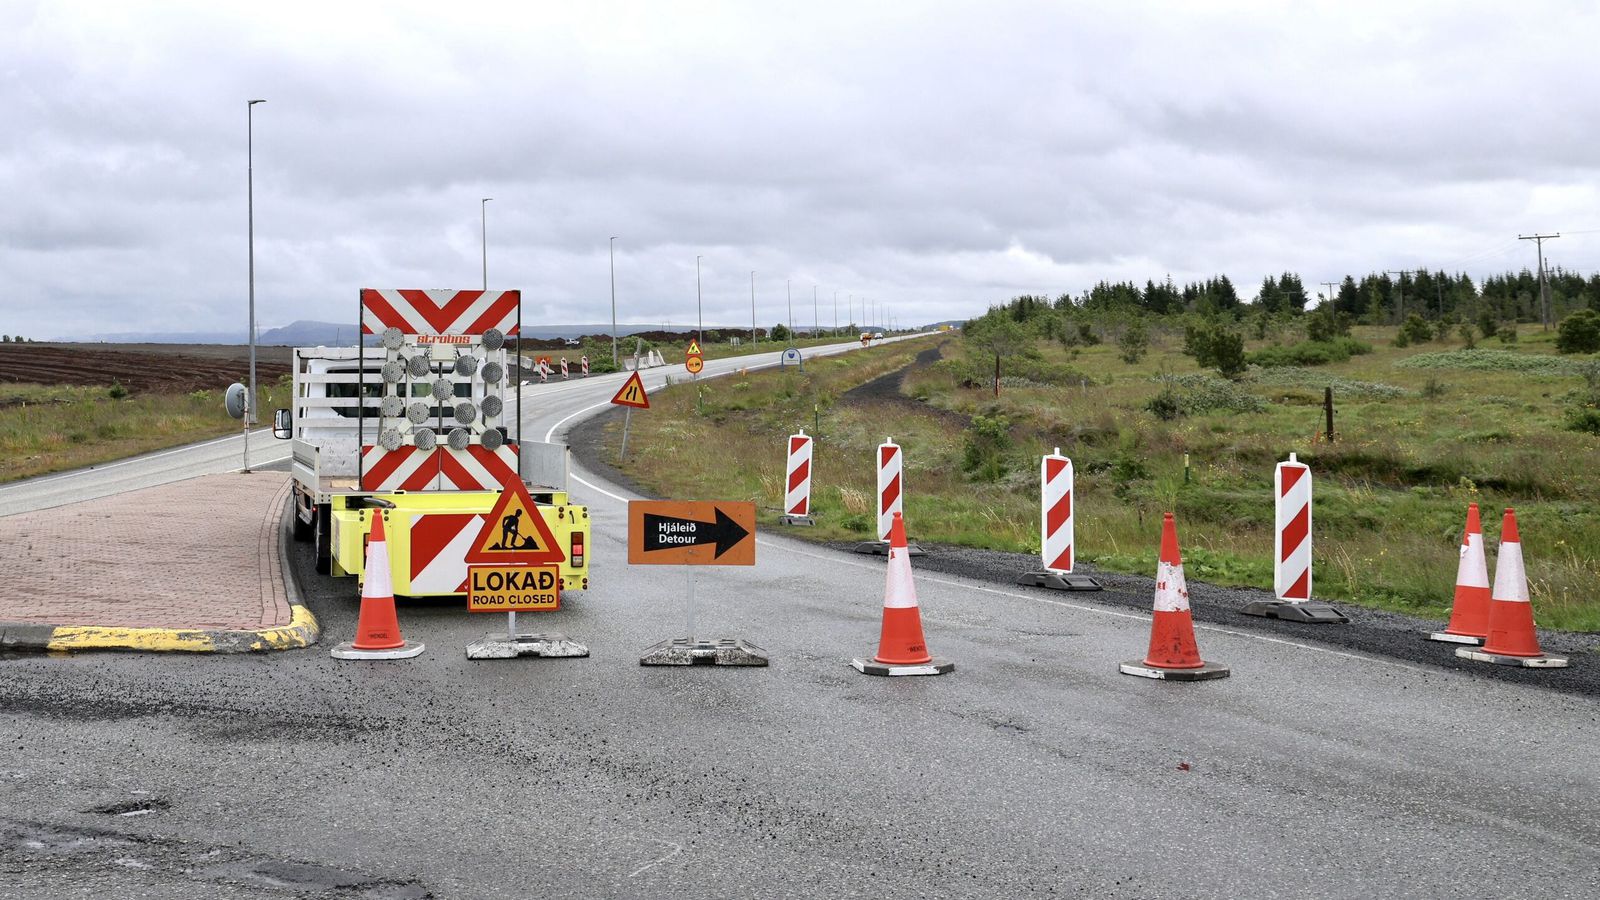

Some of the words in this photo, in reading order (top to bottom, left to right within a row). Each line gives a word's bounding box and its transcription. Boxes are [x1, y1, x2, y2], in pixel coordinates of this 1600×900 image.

[658, 522, 697, 534] Hjáleið
[658, 534, 697, 544] Detour
[473, 571, 555, 591] LOKAÐ
[473, 595, 505, 605] ROAD
[508, 594, 555, 605] CLOSED
